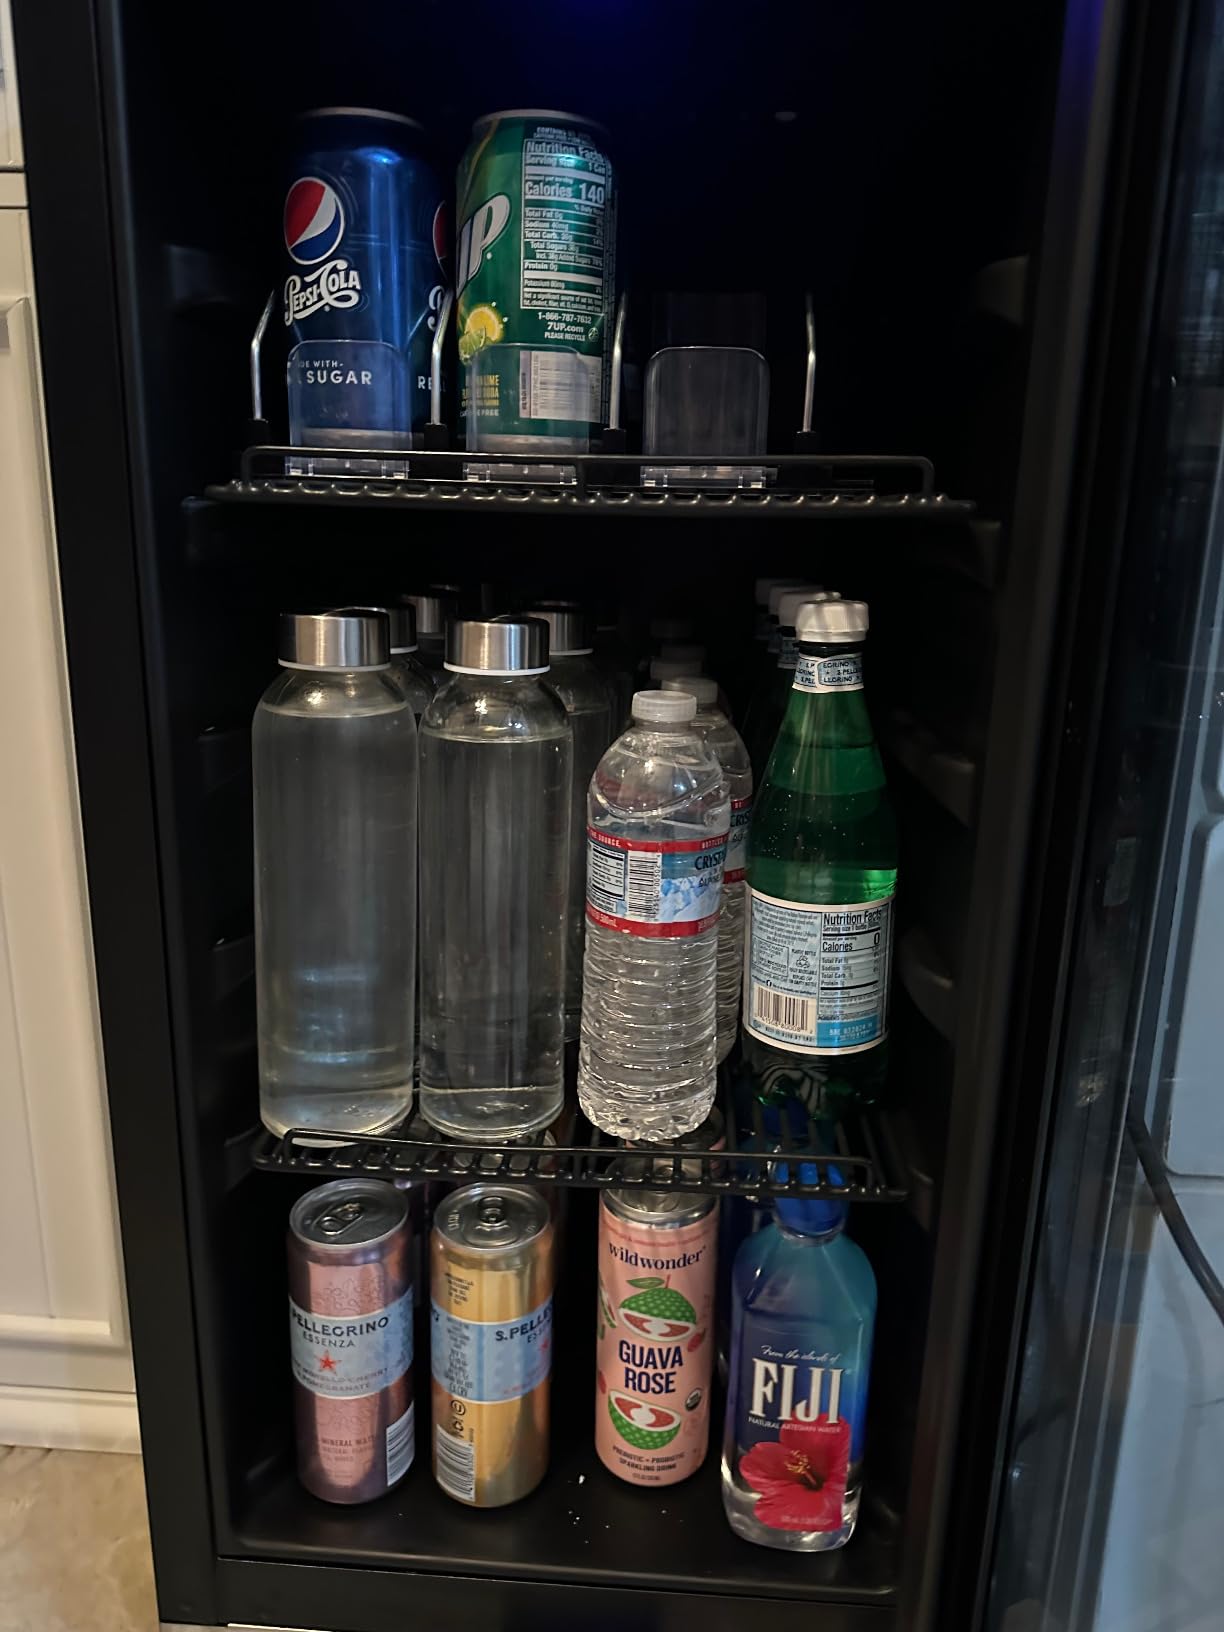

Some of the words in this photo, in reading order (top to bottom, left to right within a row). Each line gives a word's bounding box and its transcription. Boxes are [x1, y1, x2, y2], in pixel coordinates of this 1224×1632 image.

[526, 141, 577, 155] Nutrition
[525, 181, 573, 199] Calories
[579, 182, 605, 204] 140
[525, 209, 541, 218] Total
[525, 230, 541, 238] Total
[531, 241, 545, 249] Total
[547, 322, 584, 333] 7UP.com
[544, 331, 564, 340] PLEASE
[306, 370, 373, 385] SUGAR
[823, 913, 862, 926] Nutrition
[864, 909, 881, 921] Facts
[822, 941, 853, 951] Calories
[874, 932, 880, 945] 0
[608, 1242, 703, 1270] wildwonder
[303, 1331, 356, 1348] ESSENZA
[619, 1339, 684, 1370] GUAVA
[761, 1344, 784, 1357] From
[785, 1349, 800, 1359] the
[624, 1366, 677, 1395] ROSE
[749, 1357, 845, 1424] FIJI
[748, 1416, 780, 1429] NATURAL
